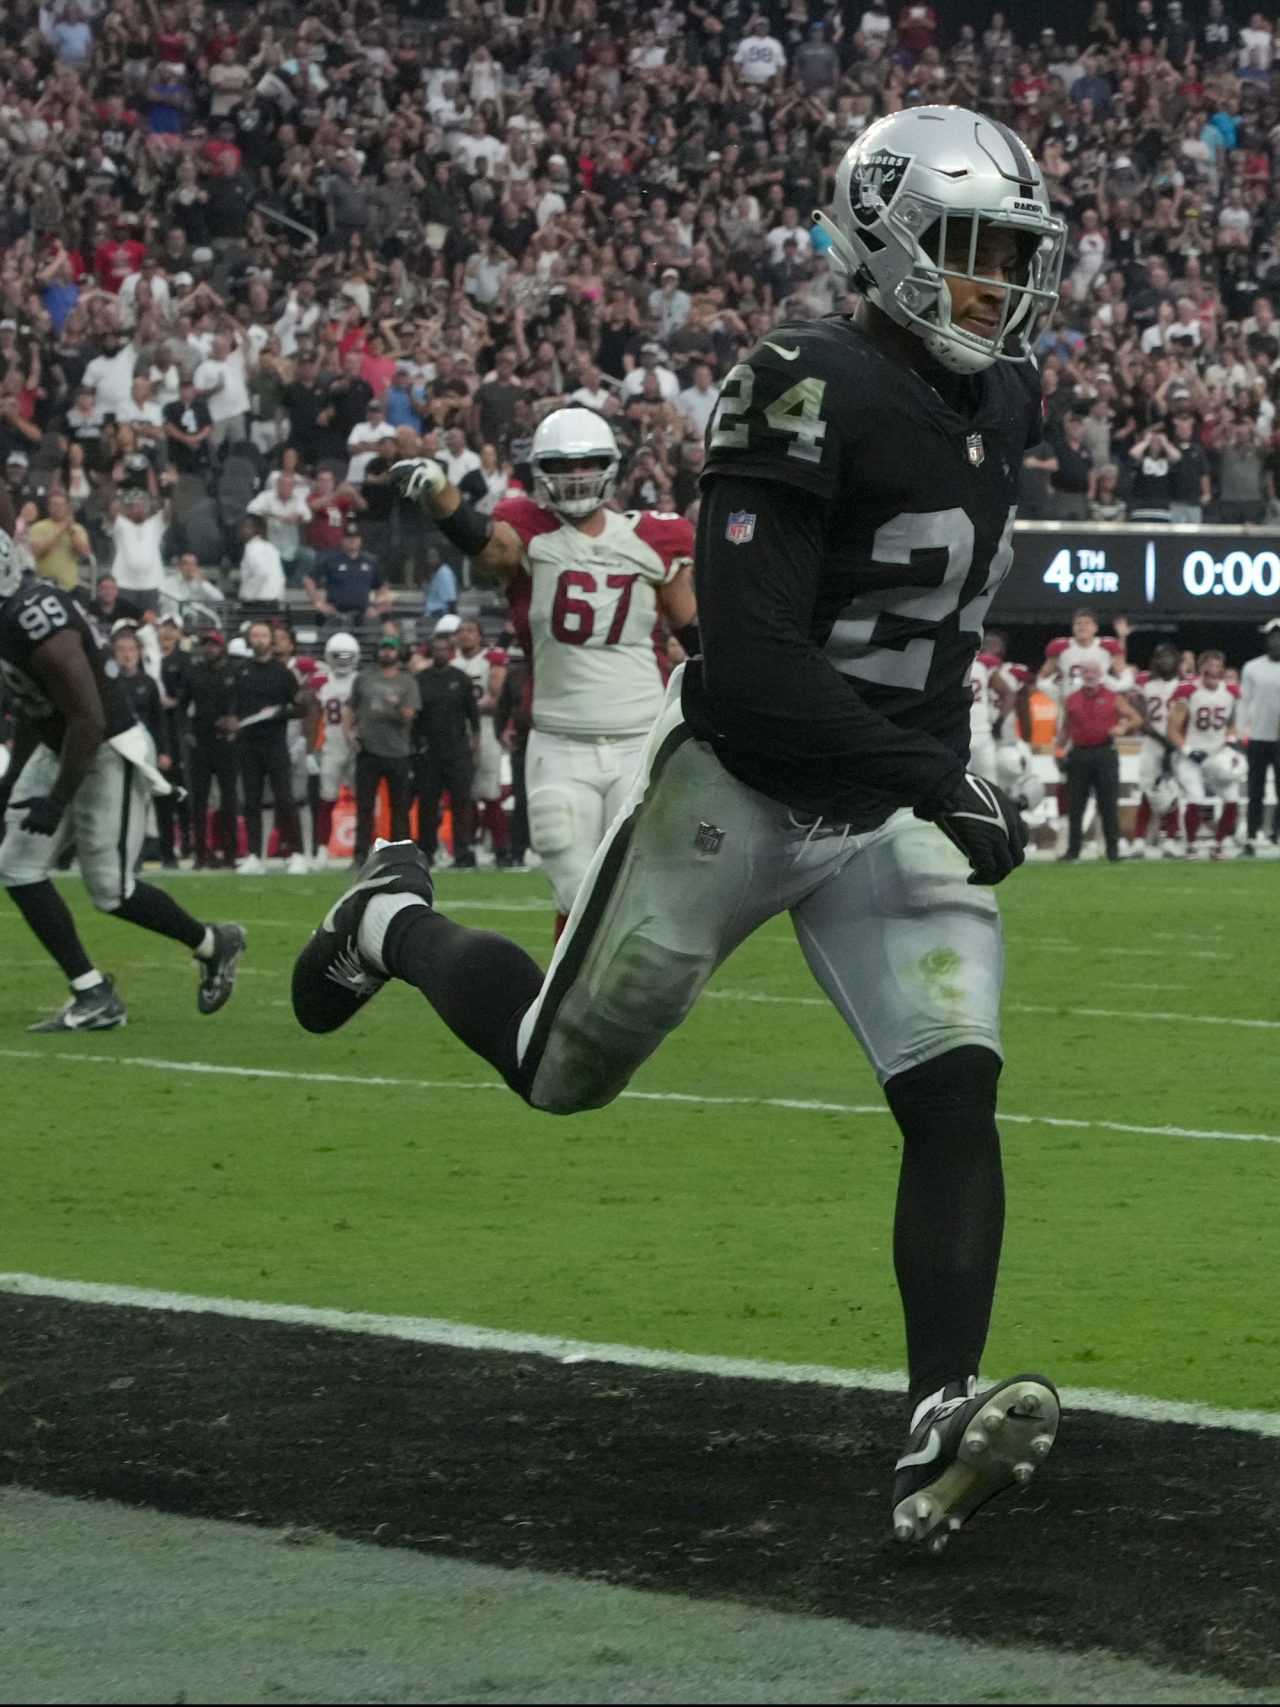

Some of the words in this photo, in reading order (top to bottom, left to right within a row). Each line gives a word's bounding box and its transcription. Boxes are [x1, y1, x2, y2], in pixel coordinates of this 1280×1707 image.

[710, 364, 827, 463] 24
[1043, 549, 1074, 593] 4
[1076, 550, 1105, 570] TH
[18, 595, 68, 640] 99
[552, 570, 639, 645] 67
[1195, 706, 1228, 731] 85
